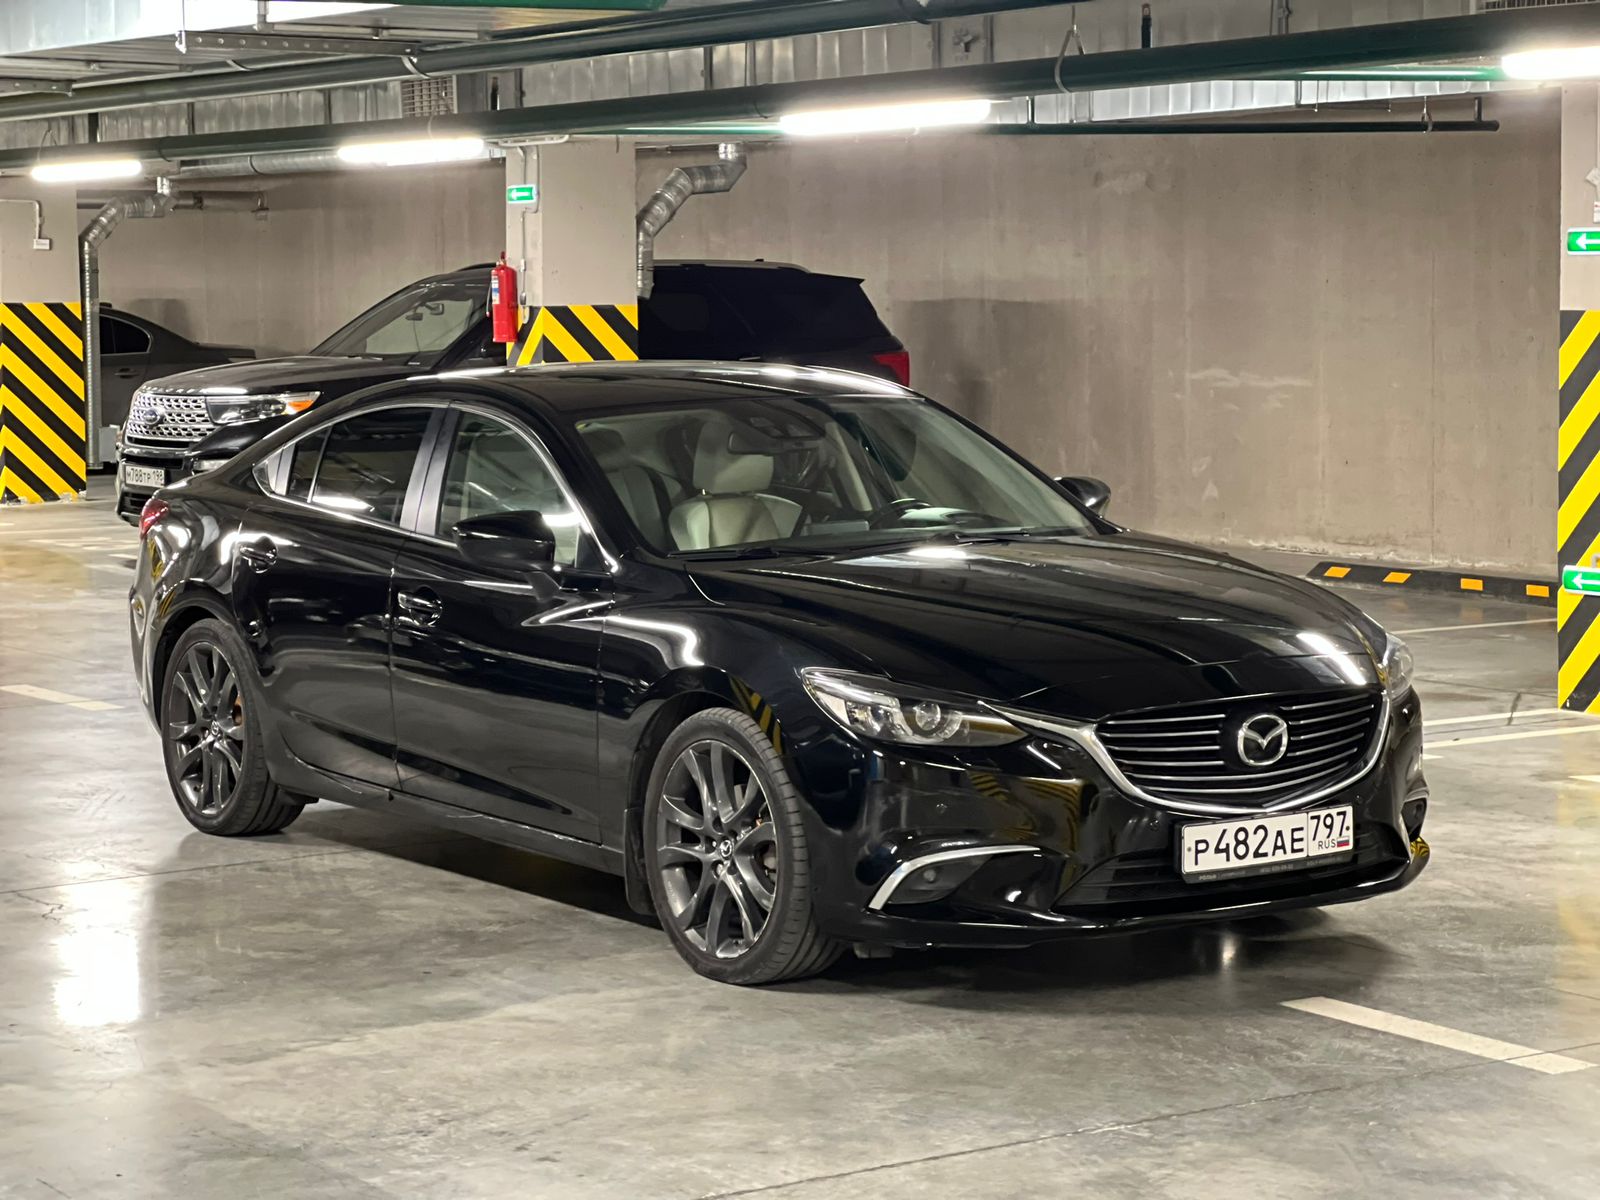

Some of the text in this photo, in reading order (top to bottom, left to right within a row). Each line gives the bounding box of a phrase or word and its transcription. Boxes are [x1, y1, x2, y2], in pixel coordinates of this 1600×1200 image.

[1194, 811, 1348, 866] P482AE 797
[1317, 838, 1336, 850] RUS
